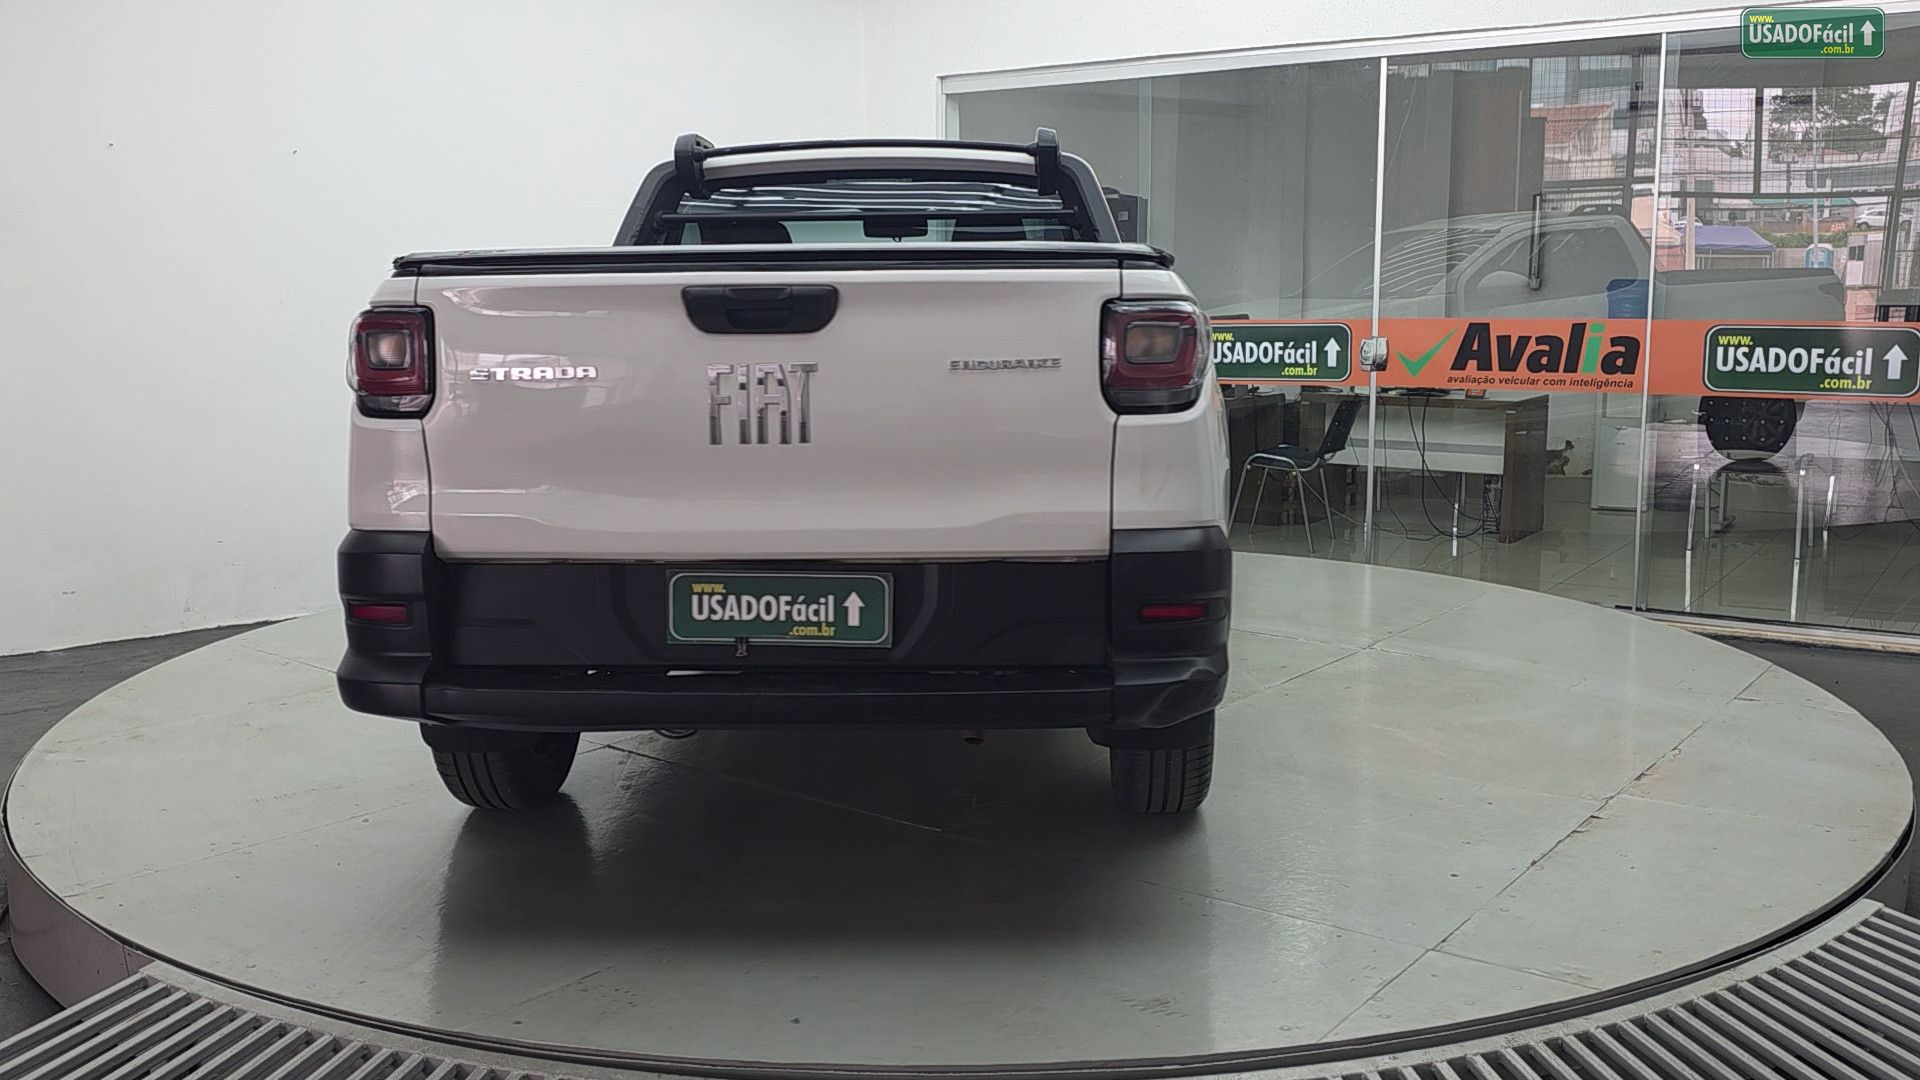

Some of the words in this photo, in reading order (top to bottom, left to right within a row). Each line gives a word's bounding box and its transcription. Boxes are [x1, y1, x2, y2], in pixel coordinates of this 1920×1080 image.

[1717, 335, 1754, 345] www.
[1211, 340, 1318, 364] USADOFácil
[1450, 322, 1641, 375] Avalia
[1716, 346, 1874, 375] USADOFácil
[469, 366, 597, 381] STRADA
[1281, 364, 1318, 376] .com.br
[1447, 374, 1496, 386] avaliação
[1498, 376, 1540, 387] veicular
[1543, 378, 1567, 387] com
[1569, 376, 1634, 389] inteligência
[1819, 375, 1873, 389] .com.br
[707, 361, 819, 445] FIAT
[691, 583, 727, 593] www.
[691, 595, 835, 622] USADOFácil
[788, 623, 836, 636] .com.br
